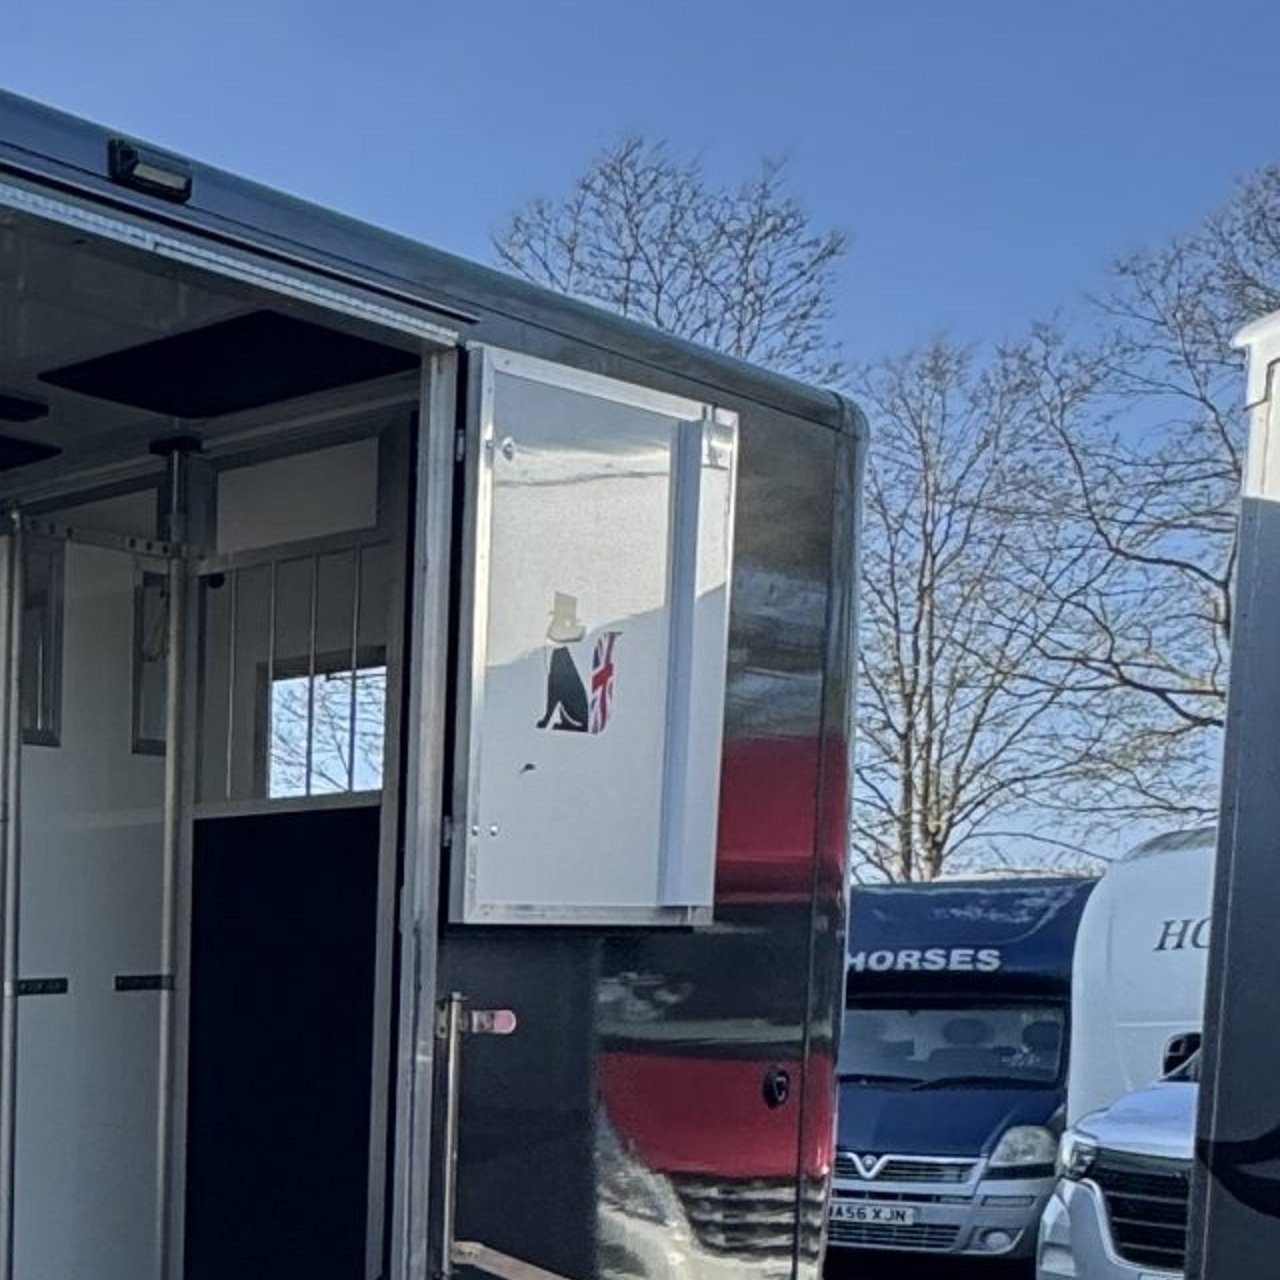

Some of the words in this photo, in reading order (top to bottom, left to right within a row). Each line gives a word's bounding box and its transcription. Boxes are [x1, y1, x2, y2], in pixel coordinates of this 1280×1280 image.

[846, 949, 1001, 972] HORSES
[829, 1206, 867, 1220] A56
[872, 1208, 906, 1222] XJN
